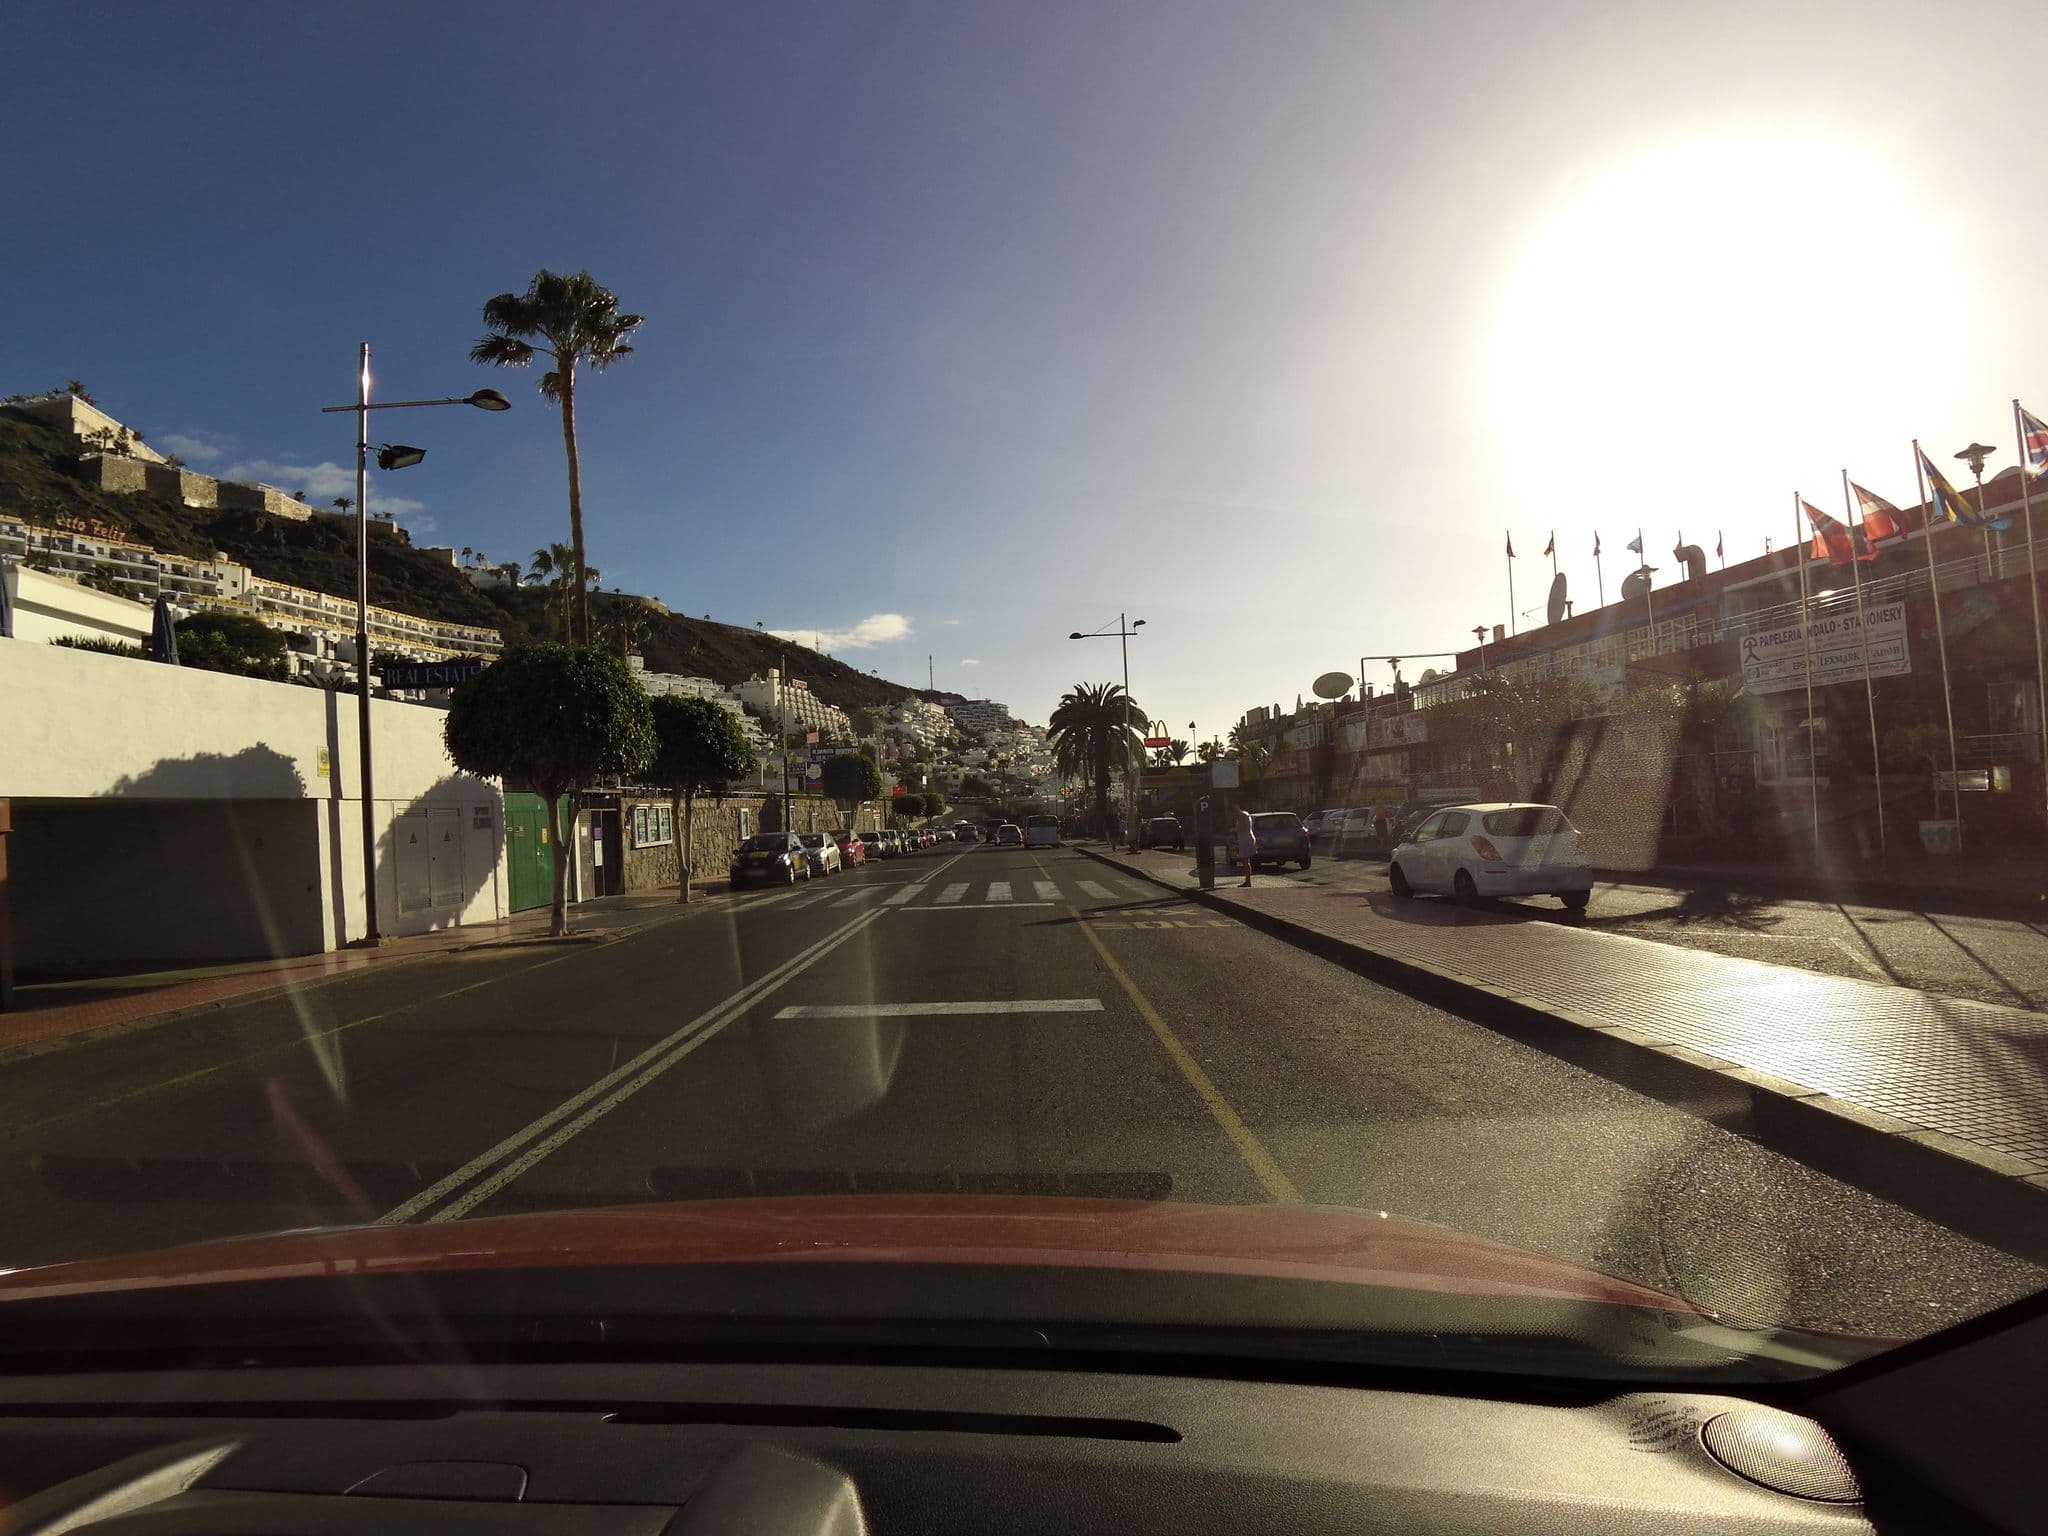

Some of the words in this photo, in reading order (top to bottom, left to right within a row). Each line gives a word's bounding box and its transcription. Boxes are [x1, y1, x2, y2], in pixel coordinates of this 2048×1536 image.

[1759, 629, 1803, 648] PAPELERIA
[1804, 620, 1836, 638] NDALO
[1843, 606, 1903, 630] STAIONERY
[386, 666, 425, 684] REAL
[1200, 801, 1209, 812] P
